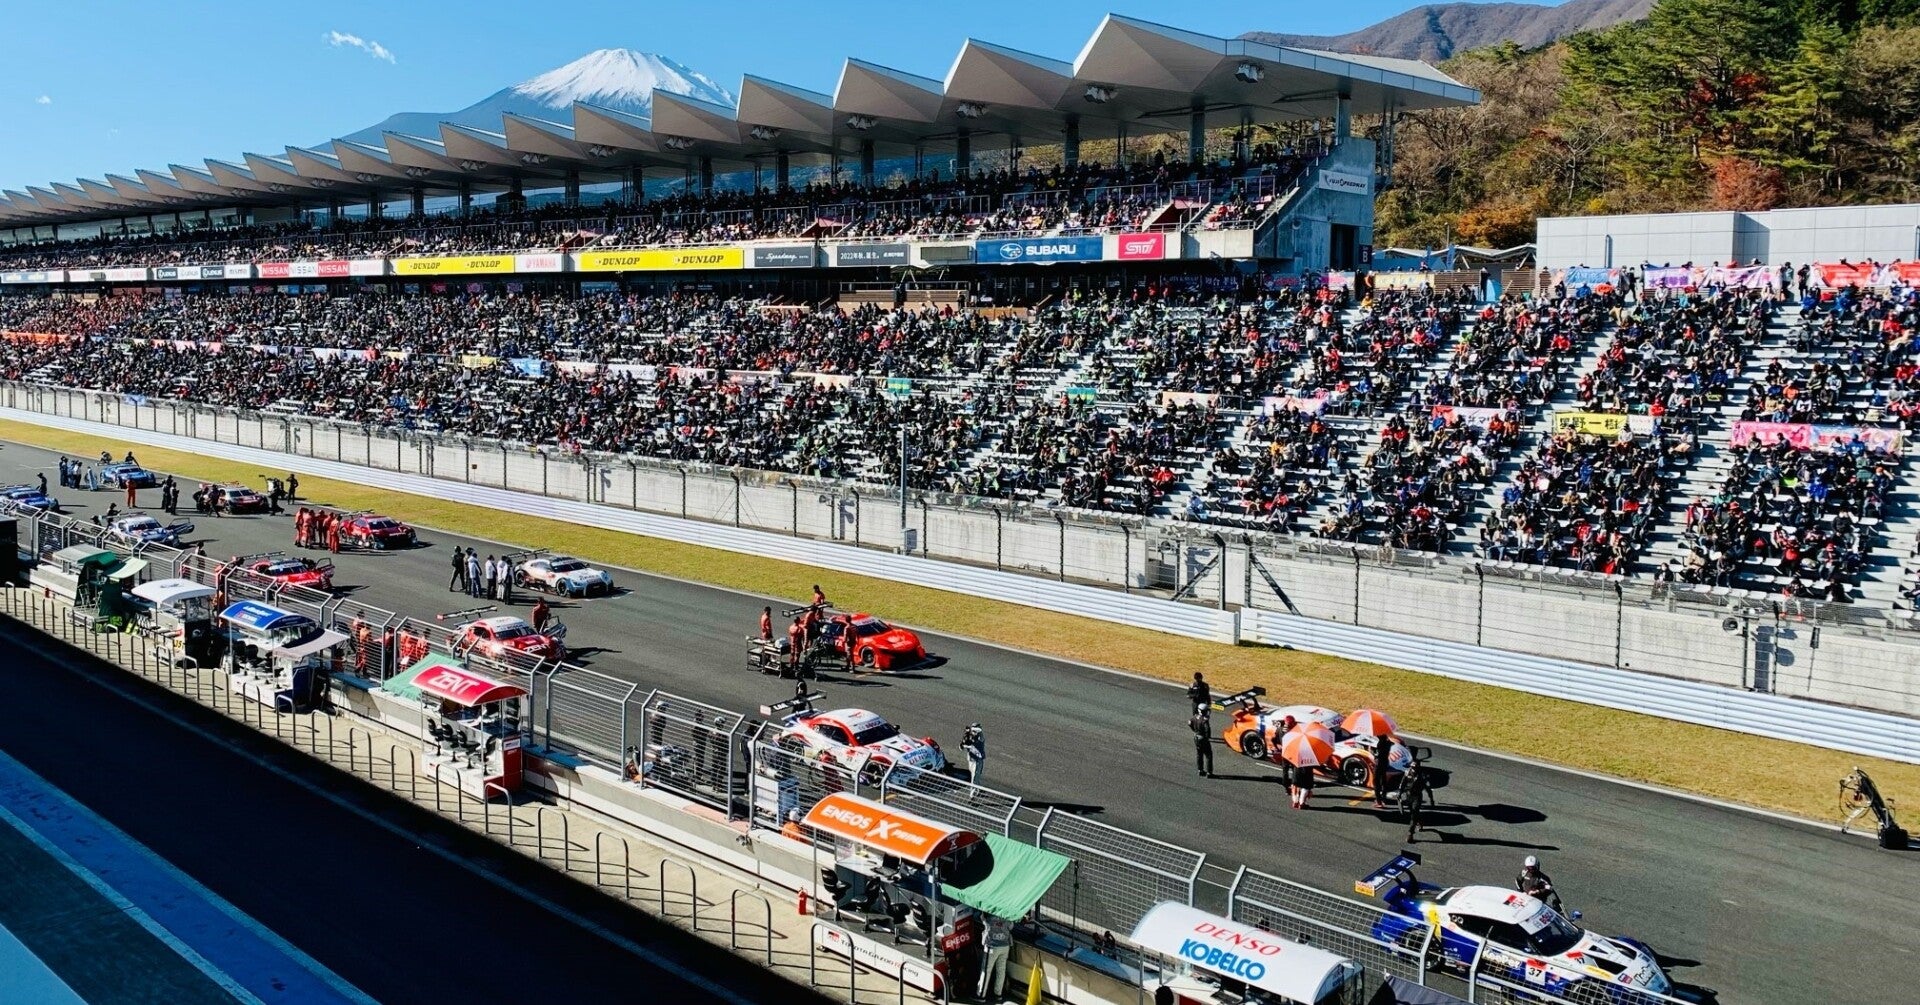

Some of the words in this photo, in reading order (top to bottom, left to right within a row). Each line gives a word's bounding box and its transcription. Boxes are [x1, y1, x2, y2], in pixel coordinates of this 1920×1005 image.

[1025, 244, 1077, 256] SUBARU
[469, 260, 501, 269] DUNLOP
[601, 257, 641, 266] DUNLOP
[681, 255, 725, 264] DUNLOP
[262, 267, 289, 275] NISSAN
[319, 265, 348, 274] NISSAN
[412, 262, 441, 270] DUNLOP
[427, 670, 481, 695] ZENT
[821, 804, 873, 830] ENEOS
[865, 819, 903, 840] X
[891, 829, 928, 845] PRIME
[945, 932, 971, 949] ENEOS
[1194, 922, 1282, 956] DENSO
[1178, 938, 1266, 981] KOBELCO
[1528, 967, 1542, 978] 37
